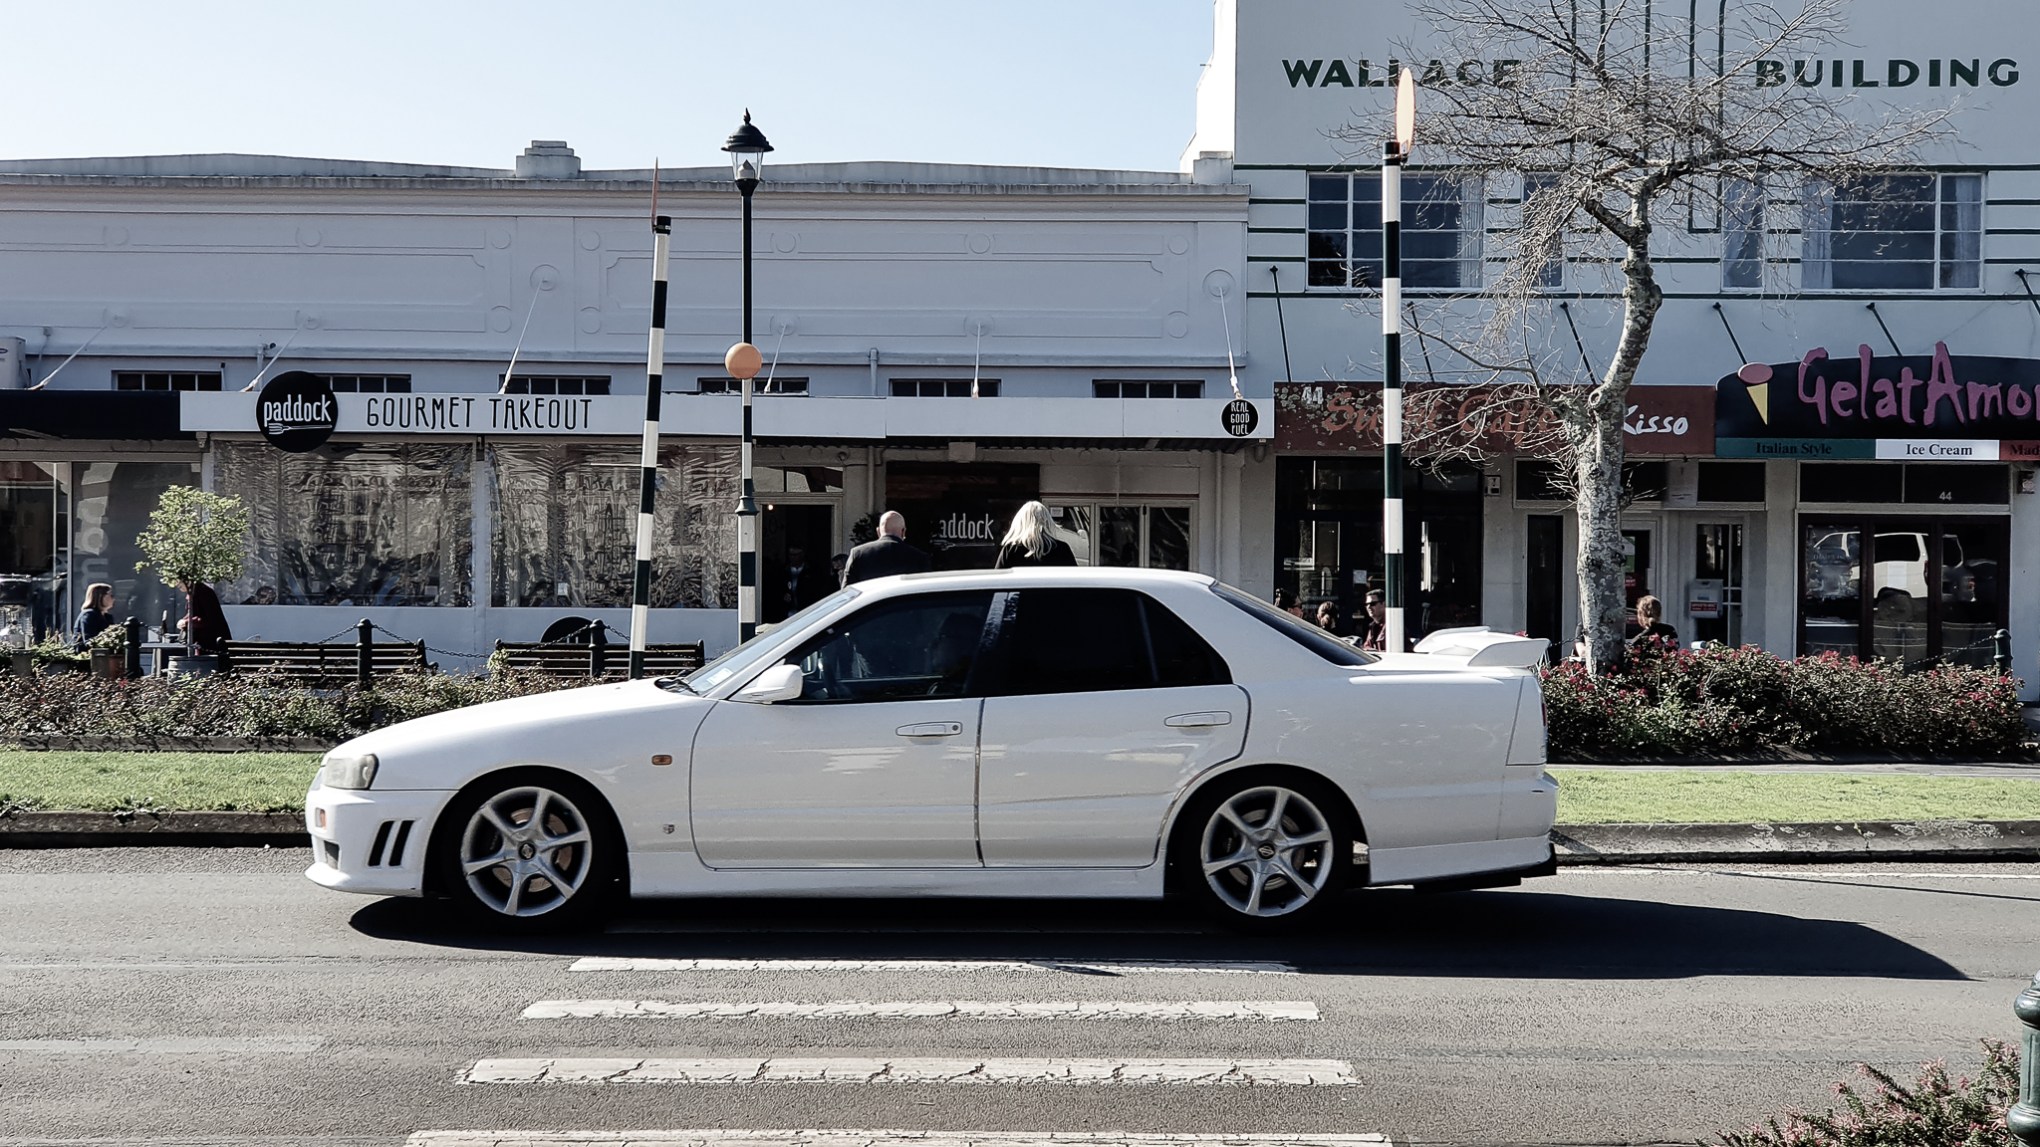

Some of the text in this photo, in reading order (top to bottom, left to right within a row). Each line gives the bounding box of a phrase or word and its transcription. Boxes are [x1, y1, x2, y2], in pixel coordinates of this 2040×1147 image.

[1282, 58, 2019, 88] WALLACE BUILDING
[264, 394, 331, 426] paddock
[367, 397, 593, 430] GOURMET TAKEOUT
[1230, 401, 1249, 413] REAL
[1230, 412, 1250, 424] GOOD
[1231, 423, 1249, 435] FUEL
[1755, 442, 1832, 456] Italian Style
[1906, 443, 1973, 455] Ice Cream
[1938, 491, 1952, 501] 44
[931, 512, 994, 540] addock
